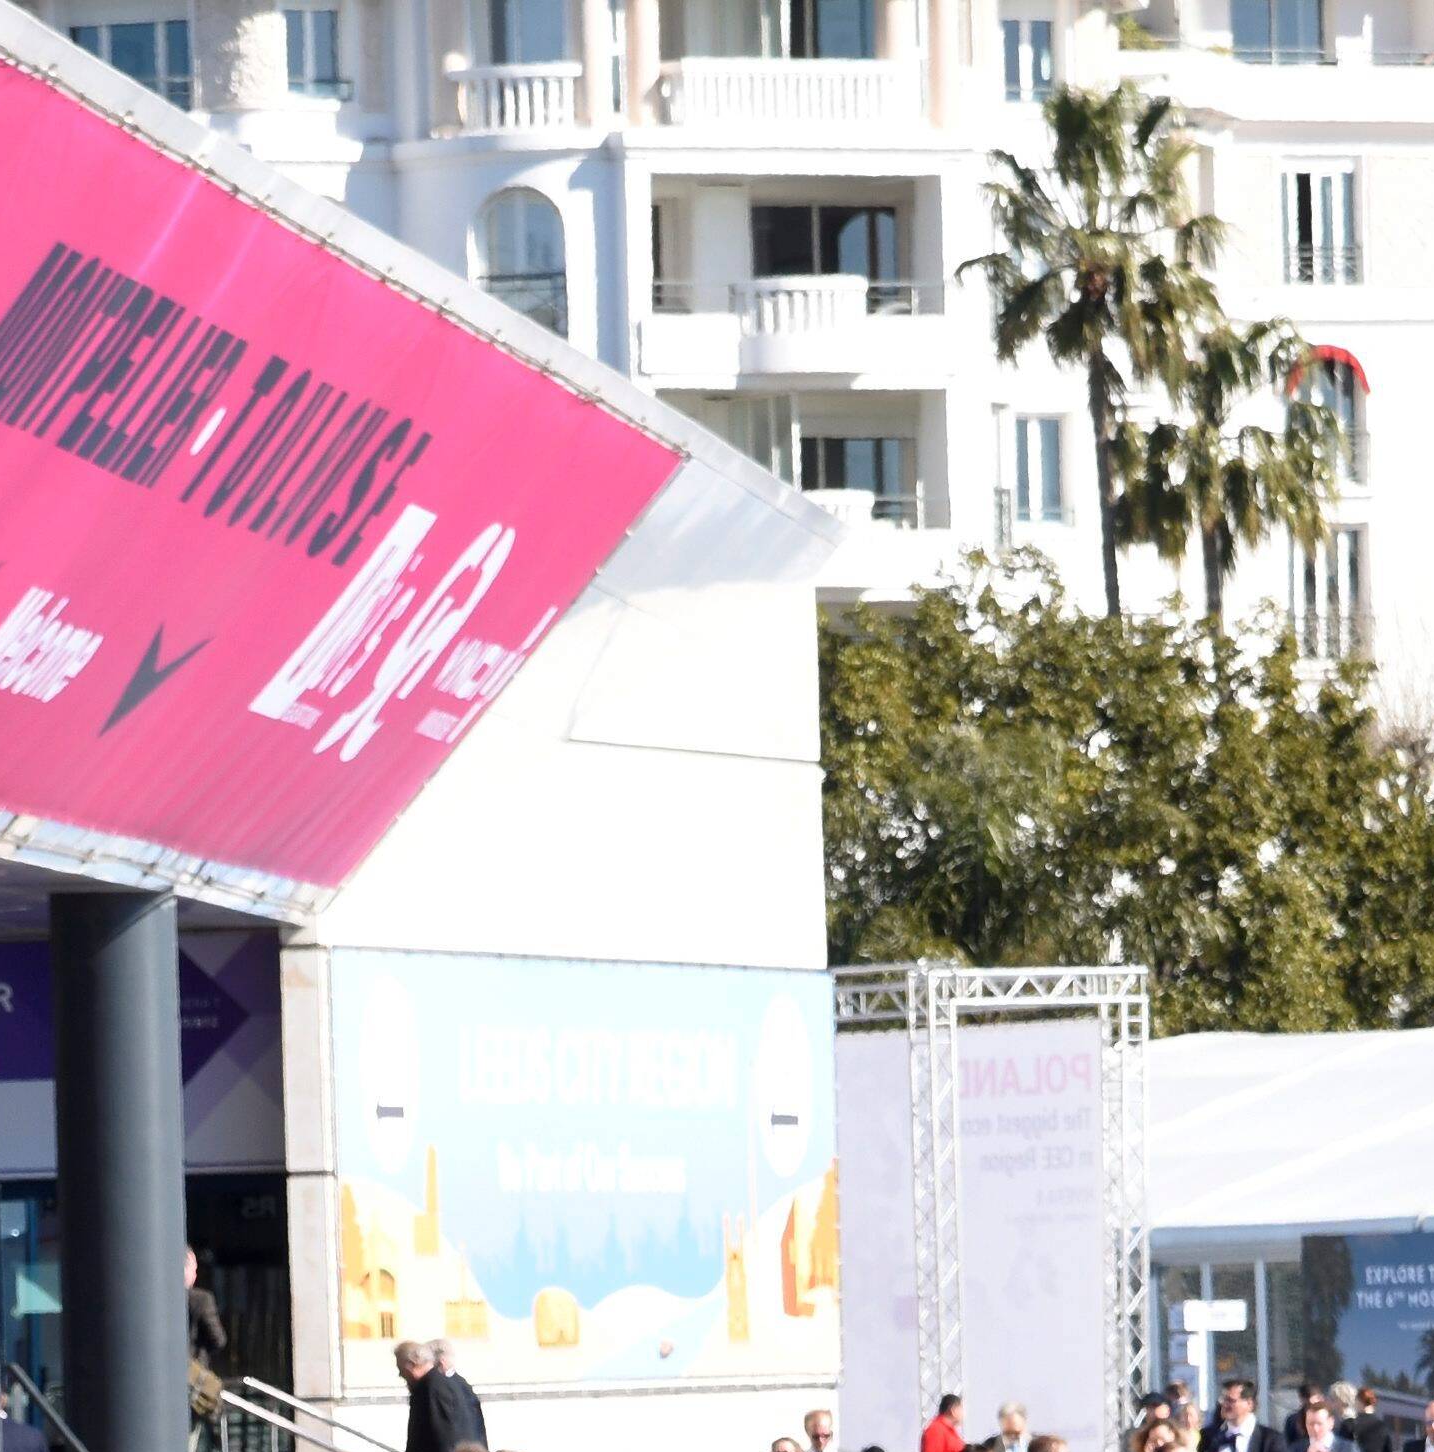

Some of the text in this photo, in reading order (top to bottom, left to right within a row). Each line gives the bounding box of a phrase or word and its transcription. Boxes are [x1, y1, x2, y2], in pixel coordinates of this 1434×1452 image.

[180, 354, 433, 568] TOULOUSE
[458, 1025, 551, 1105] LEEDS
[629, 1030, 736, 1111] REGION
[1355, 1289, 1382, 1310] THE
[1364, 1264, 1425, 1286] EXPLORE
